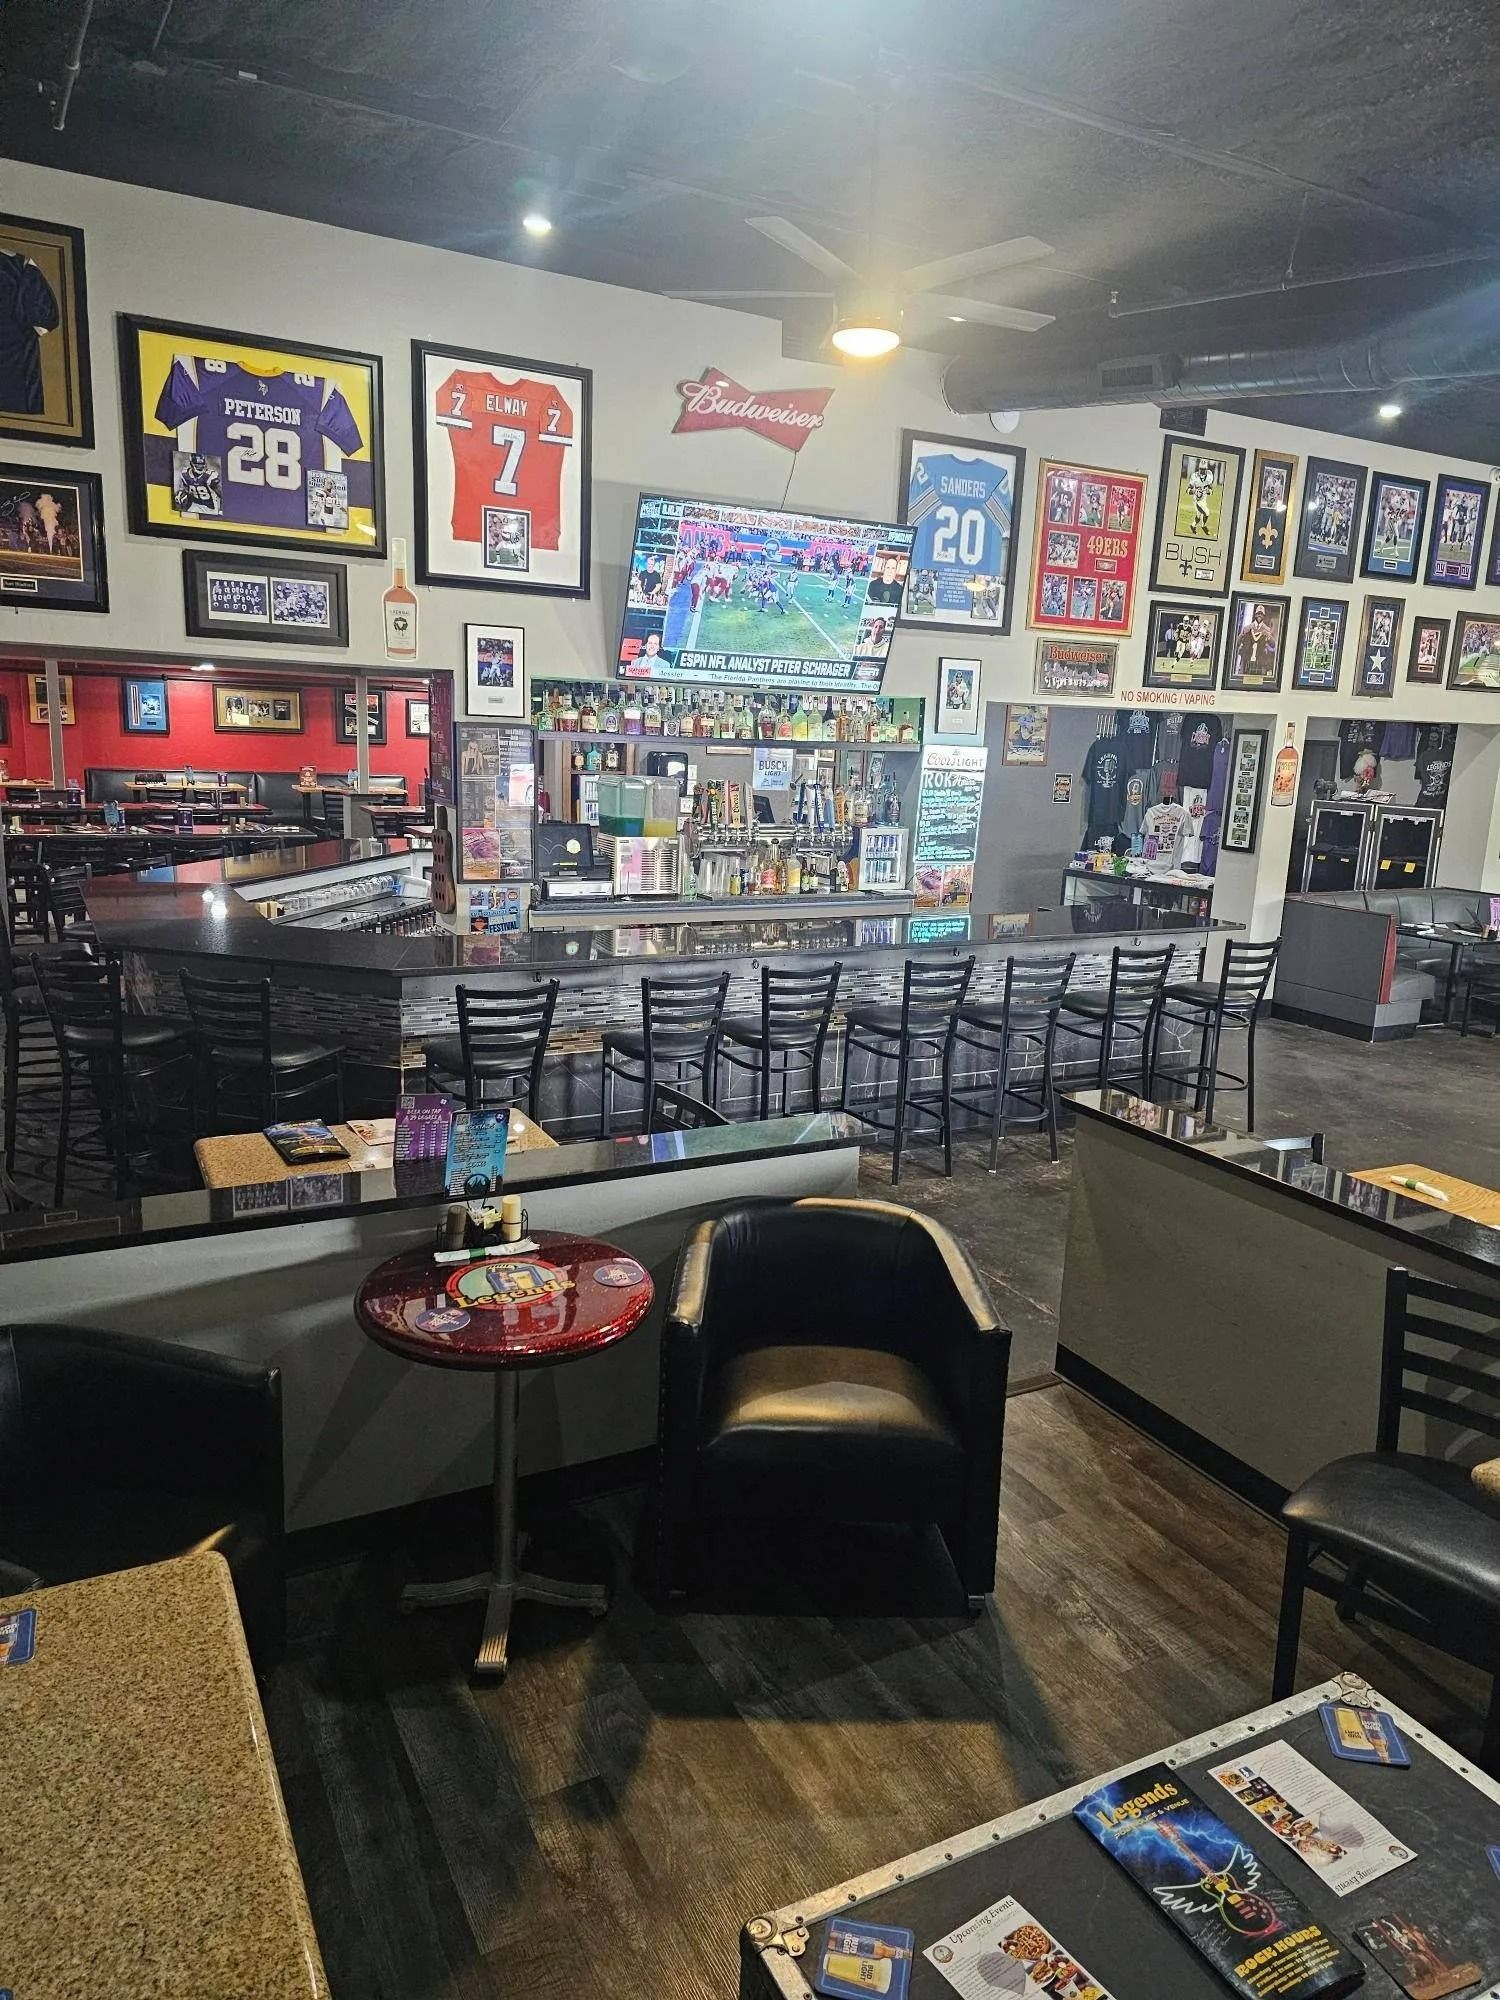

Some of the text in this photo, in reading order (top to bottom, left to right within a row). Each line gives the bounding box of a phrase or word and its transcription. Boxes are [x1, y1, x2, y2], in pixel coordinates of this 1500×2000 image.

[225, 398, 301, 425] PETERSON
[450, 391, 467, 416] 7
[486, 394, 528, 416] ELWAY
[682, 382, 824, 428] Budweiser
[547, 408, 561, 432] 7
[227, 422, 301, 490] 28
[493, 424, 526, 496] 7
[940, 475, 986, 498] SANDERS
[932, 505, 986, 566] 20
[1087, 535, 1129, 558] 49ERS
[1165, 543, 1222, 566] BUSH
[680, 652, 851, 677] ESPN NFL ANALYST PETER SCHRAGER
[1048, 645, 1106, 663] Budweiser
[1121, 690, 1134, 702] NO
[1136, 691, 1177, 704] SMOKING
[1184, 693, 1216, 706] VAPING
[758, 760, 788, 772] BUSCH
[956, 757, 984, 768] LIGHT
[489, 921, 518, 932] FESTIVAL
[453, 1280, 576, 1309] Legends
[1096, 1783, 1178, 1828] Legends
[1163, 1798, 1190, 1812] VENUE
[948, 1898, 1016, 1945] Upcoming Events
[1234, 1925, 1322, 1978] ROCK HOURS
[860, 1960, 868, 1982] LIGHT
[866, 1964, 874, 1981] BUD
